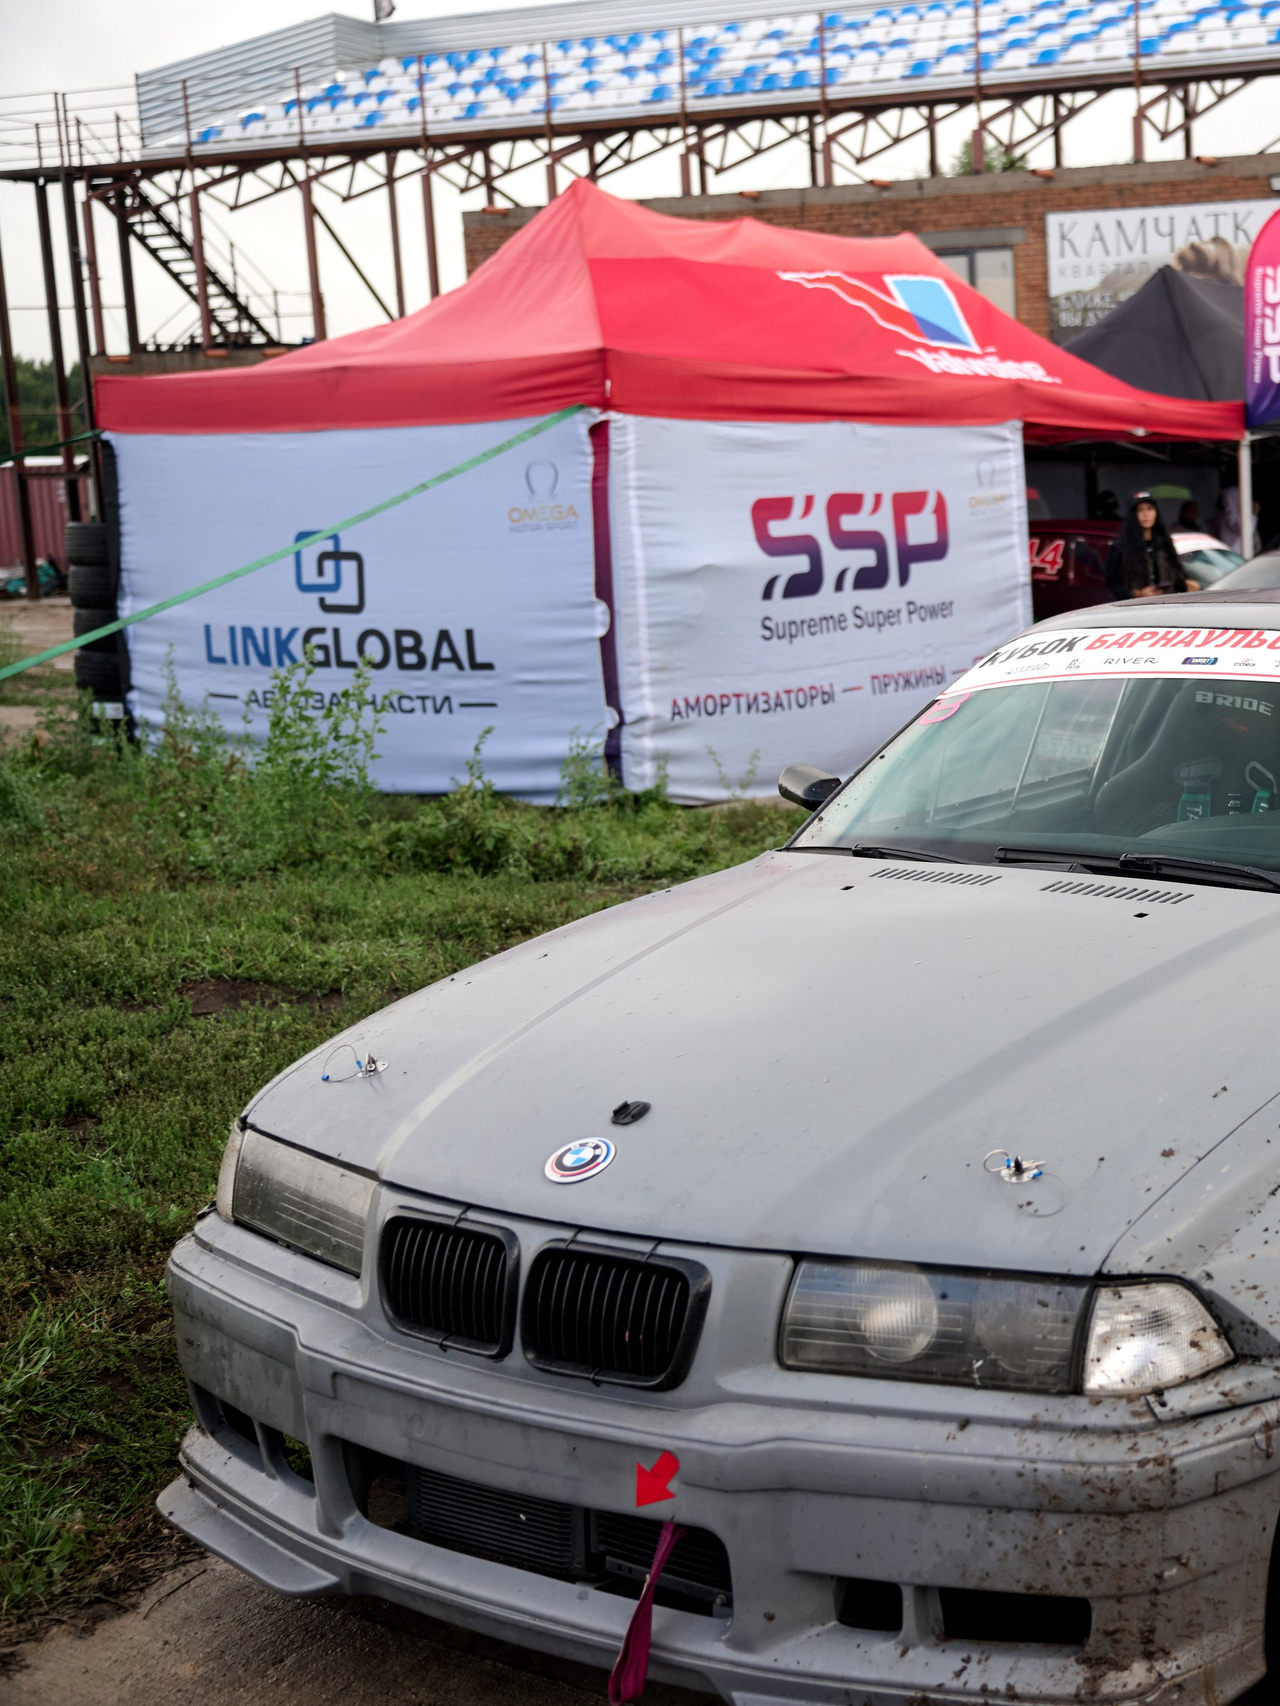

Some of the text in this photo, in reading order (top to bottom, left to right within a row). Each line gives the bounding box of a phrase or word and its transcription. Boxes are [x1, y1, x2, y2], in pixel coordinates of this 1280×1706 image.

[1058, 211, 1254, 258] КАМЧАТК
[507, 504, 580, 523] OMEGA
[750, 490, 949, 600] SSP
[761, 600, 955, 643] Supreme Super Power
[203, 624, 496, 671] LINKGLOBAL
[978, 635, 1090, 668] КУБОК
[1103, 656, 1159, 666] RIVER
[671, 666, 947, 721] АМОРТИЗАТОРЫ ПРУЖИНЫ
[1195, 691, 1275, 716] BRIDE
